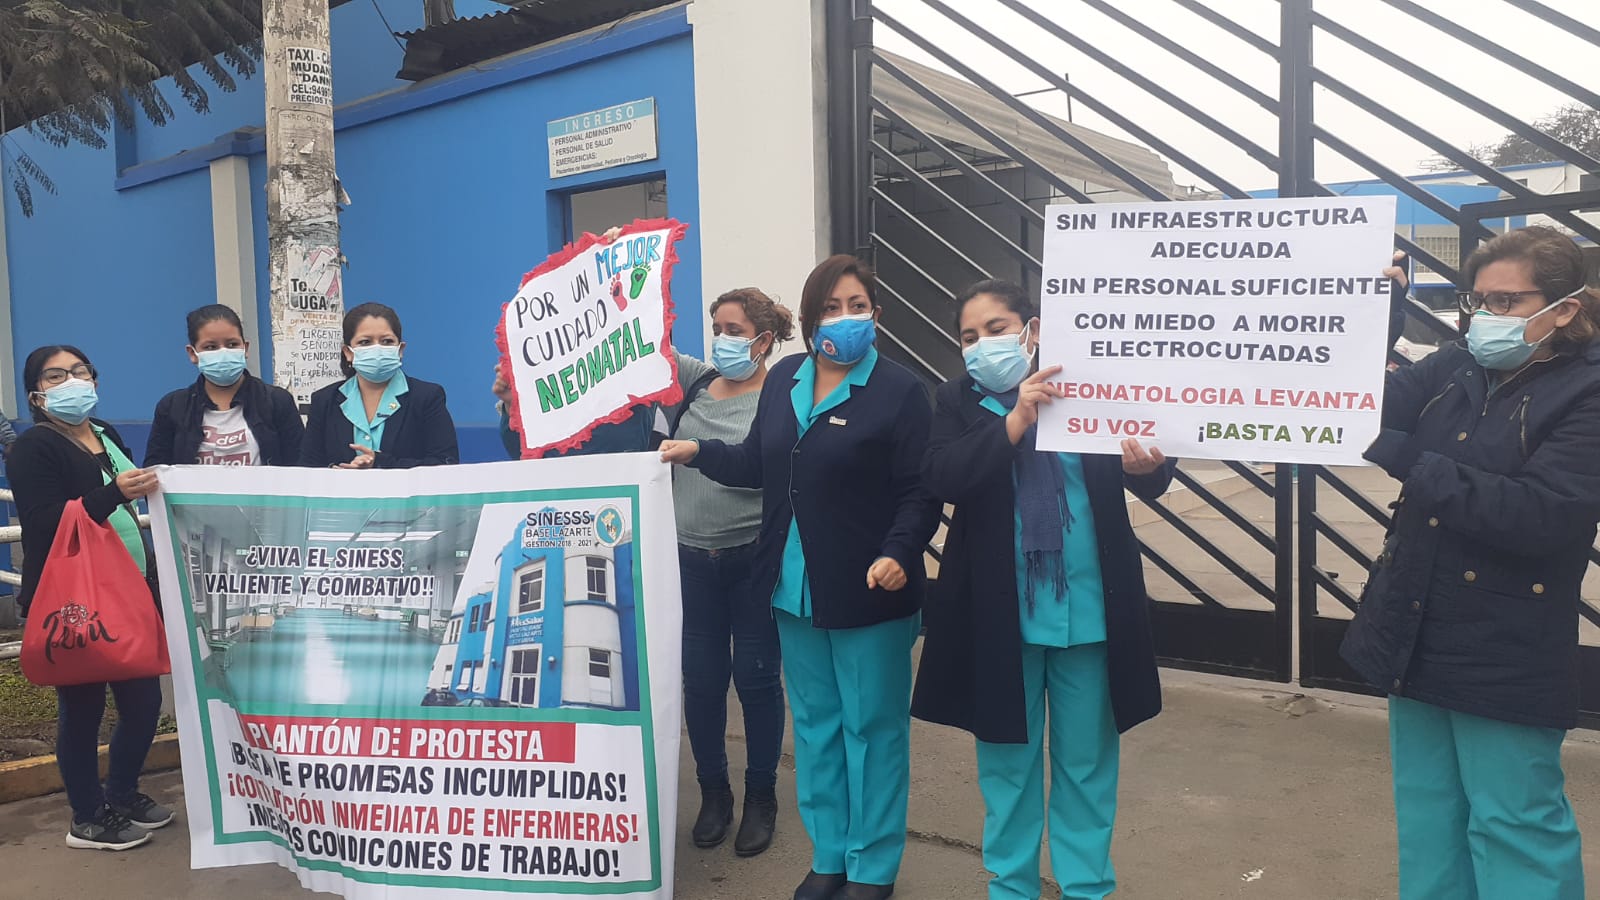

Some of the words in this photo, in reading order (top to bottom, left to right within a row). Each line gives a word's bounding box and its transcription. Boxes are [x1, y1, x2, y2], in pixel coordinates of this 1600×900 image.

[288, 48, 314, 61] TAXI
[565, 106, 634, 133] INGRESO
[555, 134, 584, 146] PERSONAL
[585, 122, 632, 140] ADMINISTRATIVO
[555, 144, 584, 155] PERSONAL
[585, 141, 593, 149] DE
[594, 138, 613, 149] SALUD
[556, 152, 597, 167] EMERGENCIAS:
[1056, 214, 1096, 230] SIN
[1111, 207, 1368, 229] INFRAESTRUCTURA
[1150, 242, 1291, 259] ADECUADA
[514, 291, 560, 329] POR
[571, 270, 589, 303] UN
[595, 234, 661, 285] MEJOR
[1046, 278, 1085, 295] SIN
[1093, 278, 1226, 296] PERSONAL
[1230, 277, 1390, 296] SUFICIENTE
[523, 299, 607, 367] CUIDADO
[1074, 313, 1126, 330] CON
[1134, 313, 1216, 331] MIEDO
[1232, 315, 1250, 332] A
[1258, 315, 1345, 333] MORIR
[1090, 340, 1331, 364] ELECTROCUTADAS
[535, 317, 655, 413] NEONATAL
[1254, 388, 1377, 411] LEVANTA
[216, 432, 244, 445] der
[1067, 417, 1098, 434] SU
[1106, 419, 1156, 437] VOZ
[1198, 422, 1292, 443] ¡BASTA
[1300, 426, 1343, 444] YA!
[526, 511, 590, 526] SINESSS
[525, 528, 549, 538] BASE
[552, 527, 592, 537] LAZARTE
[578, 539, 592, 547] 2021
[247, 547, 300, 568] ¿VIVA
[308, 548, 330, 568] EL
[205, 574, 292, 595] VALIENTE
[299, 576, 312, 595] Y
[43, 611, 120, 664] Perú
[247, 719, 361, 757] PLANTÓN
[409, 728, 544, 760] PROTESTA
[298, 762, 434, 795] PROMESAS
[443, 767, 627, 802] INCUMPLIDAS!
[447, 807, 475, 836] DE
[483, 809, 639, 844] ENFERMERAS!
[461, 843, 490, 872] DE
[500, 844, 620, 877] TRABAJO!
